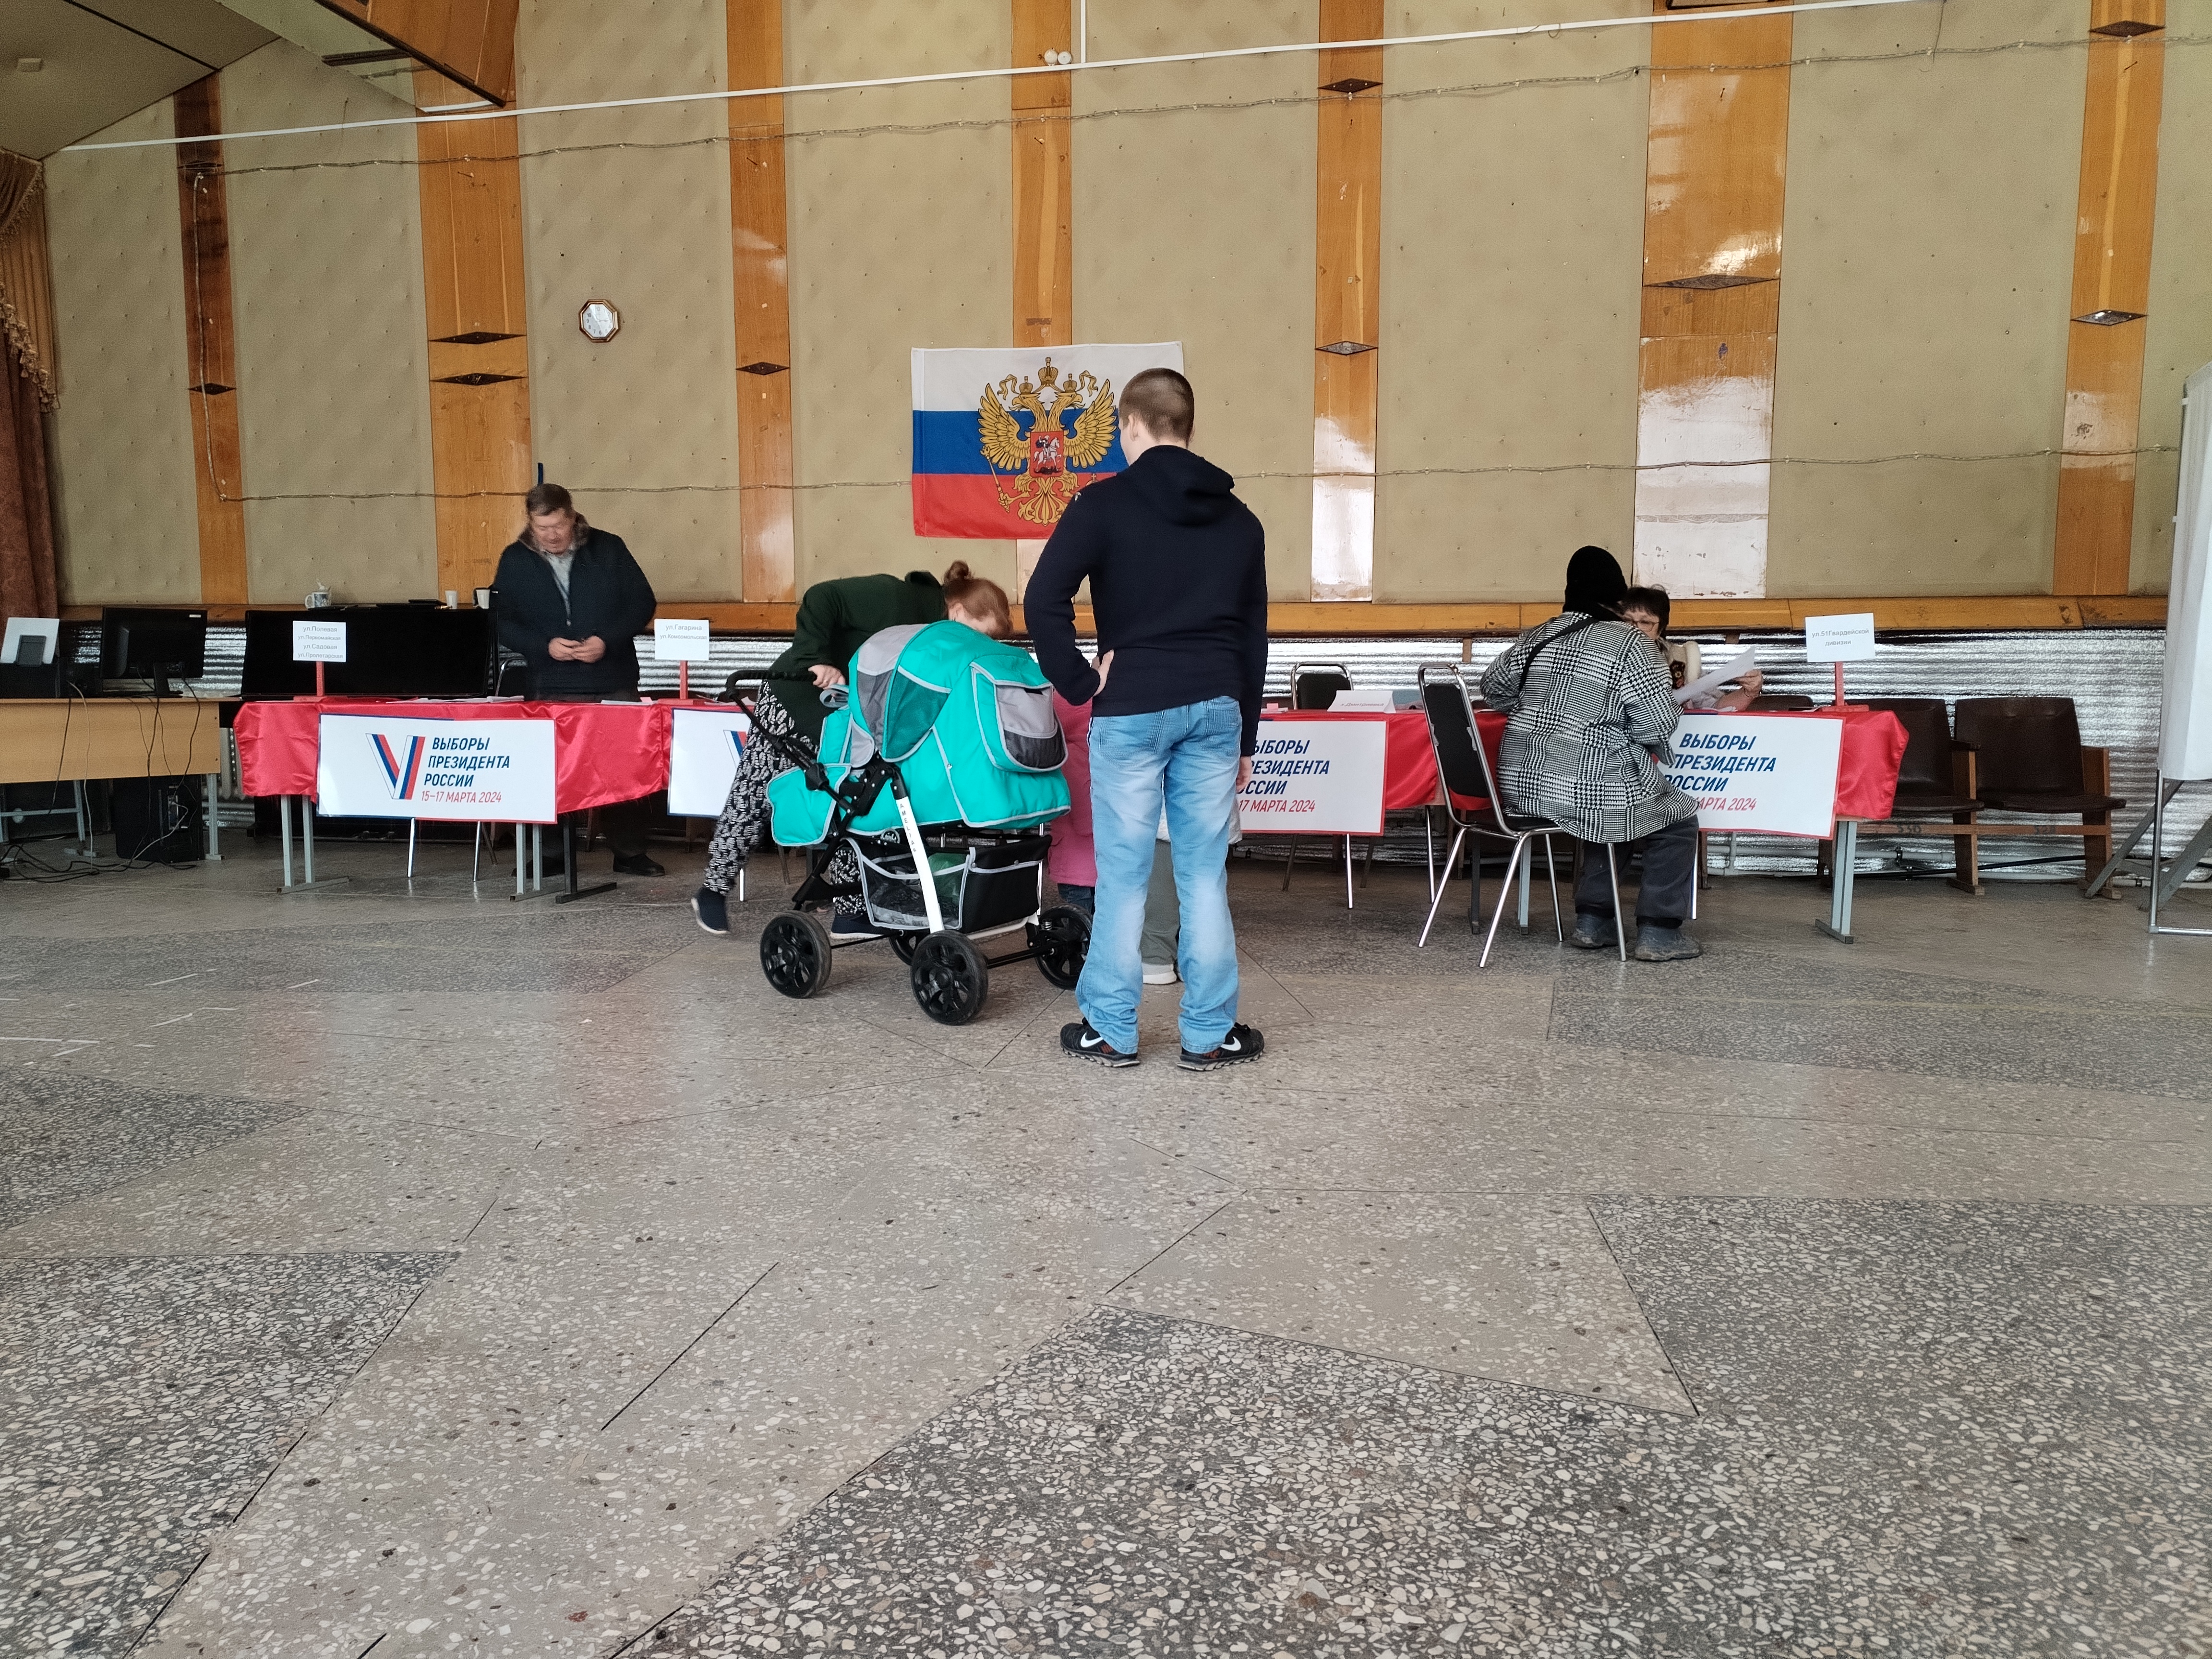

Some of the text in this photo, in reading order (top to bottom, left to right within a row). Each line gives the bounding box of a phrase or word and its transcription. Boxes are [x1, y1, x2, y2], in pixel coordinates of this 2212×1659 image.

[1812, 628, 1869, 638] ул.51Гвардейской
[432, 737, 490, 750] ВЫБОРЫ
[1254, 740, 1310, 754] ЫБОРЫ
[1679, 733, 1757, 750] ВЫБОРЫ
[428, 756, 510, 771] ПРЕЗИДЕНТА
[1251, 760, 1330, 777] ЕЗИДЕНТА
[1669, 754, 1776, 773] ПРЕЗИДЕНТА
[424, 773, 474, 787] РОССИИ
[1236, 781, 1287, 794] ССИИ
[445, 792, 476, 803] МАРТА
[478, 792, 502, 803] 2024
[1696, 797, 1757, 811] АРТА 2024
[1250, 800, 1287, 812] МАРТА
[1288, 800, 1316, 812] 2024
